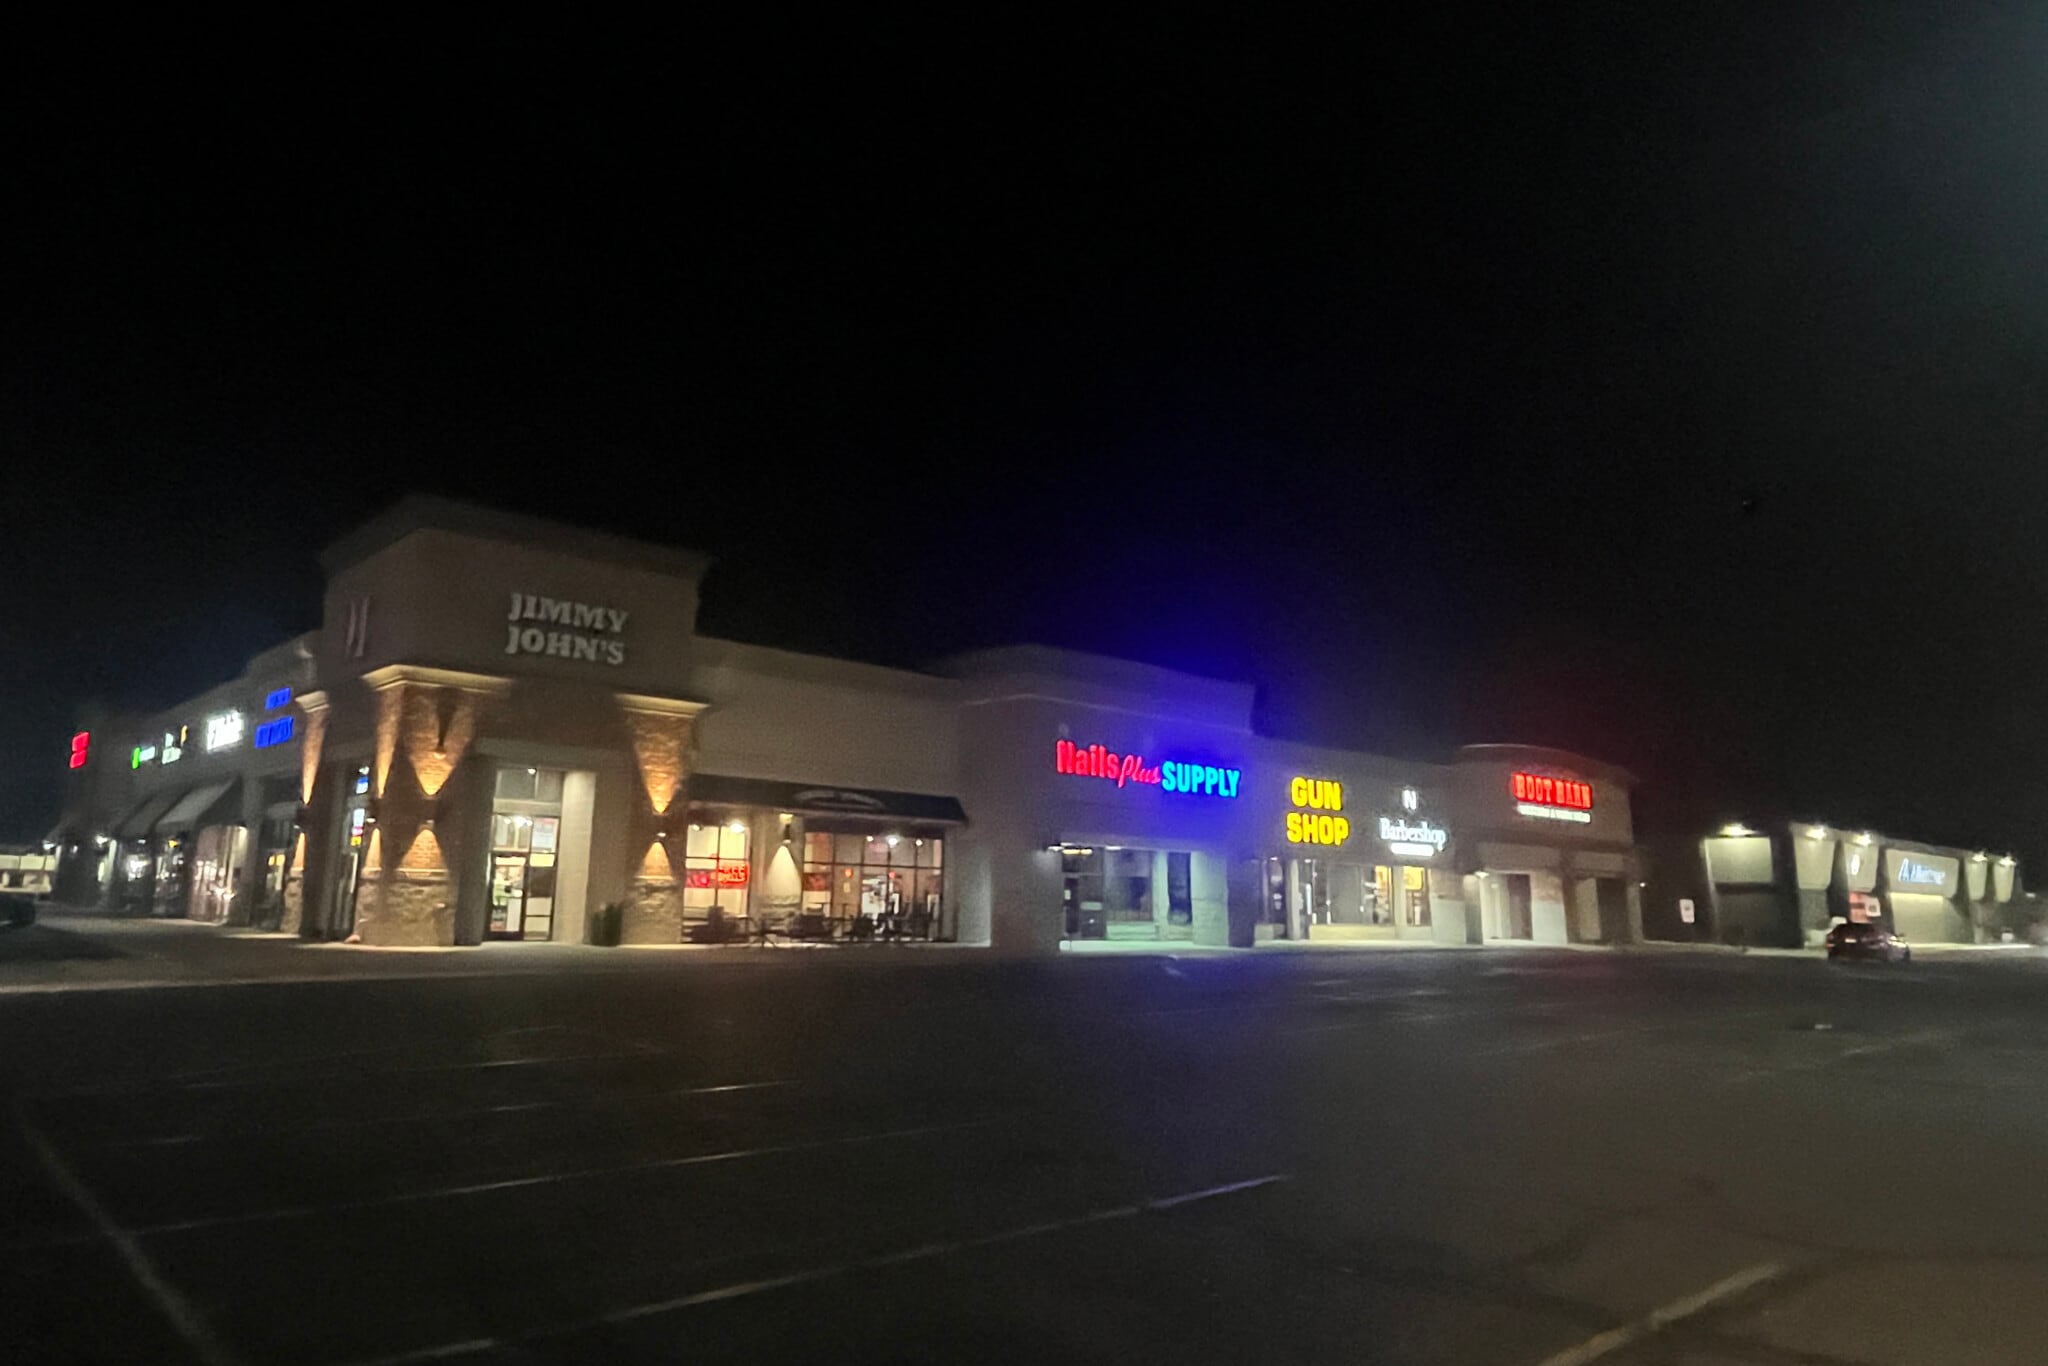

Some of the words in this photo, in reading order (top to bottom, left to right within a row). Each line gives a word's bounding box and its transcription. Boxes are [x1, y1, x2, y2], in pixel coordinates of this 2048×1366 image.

[508, 592, 629, 633] JIMMY
[504, 625, 625, 665] JOHN'S
[1056, 740, 1120, 780] Nails
[1162, 760, 1241, 799] SUPPLY
[1291, 776, 1343, 811] GUN
[1286, 812, 1350, 846] SHOP
[1379, 816, 1448, 852] Barbershop
